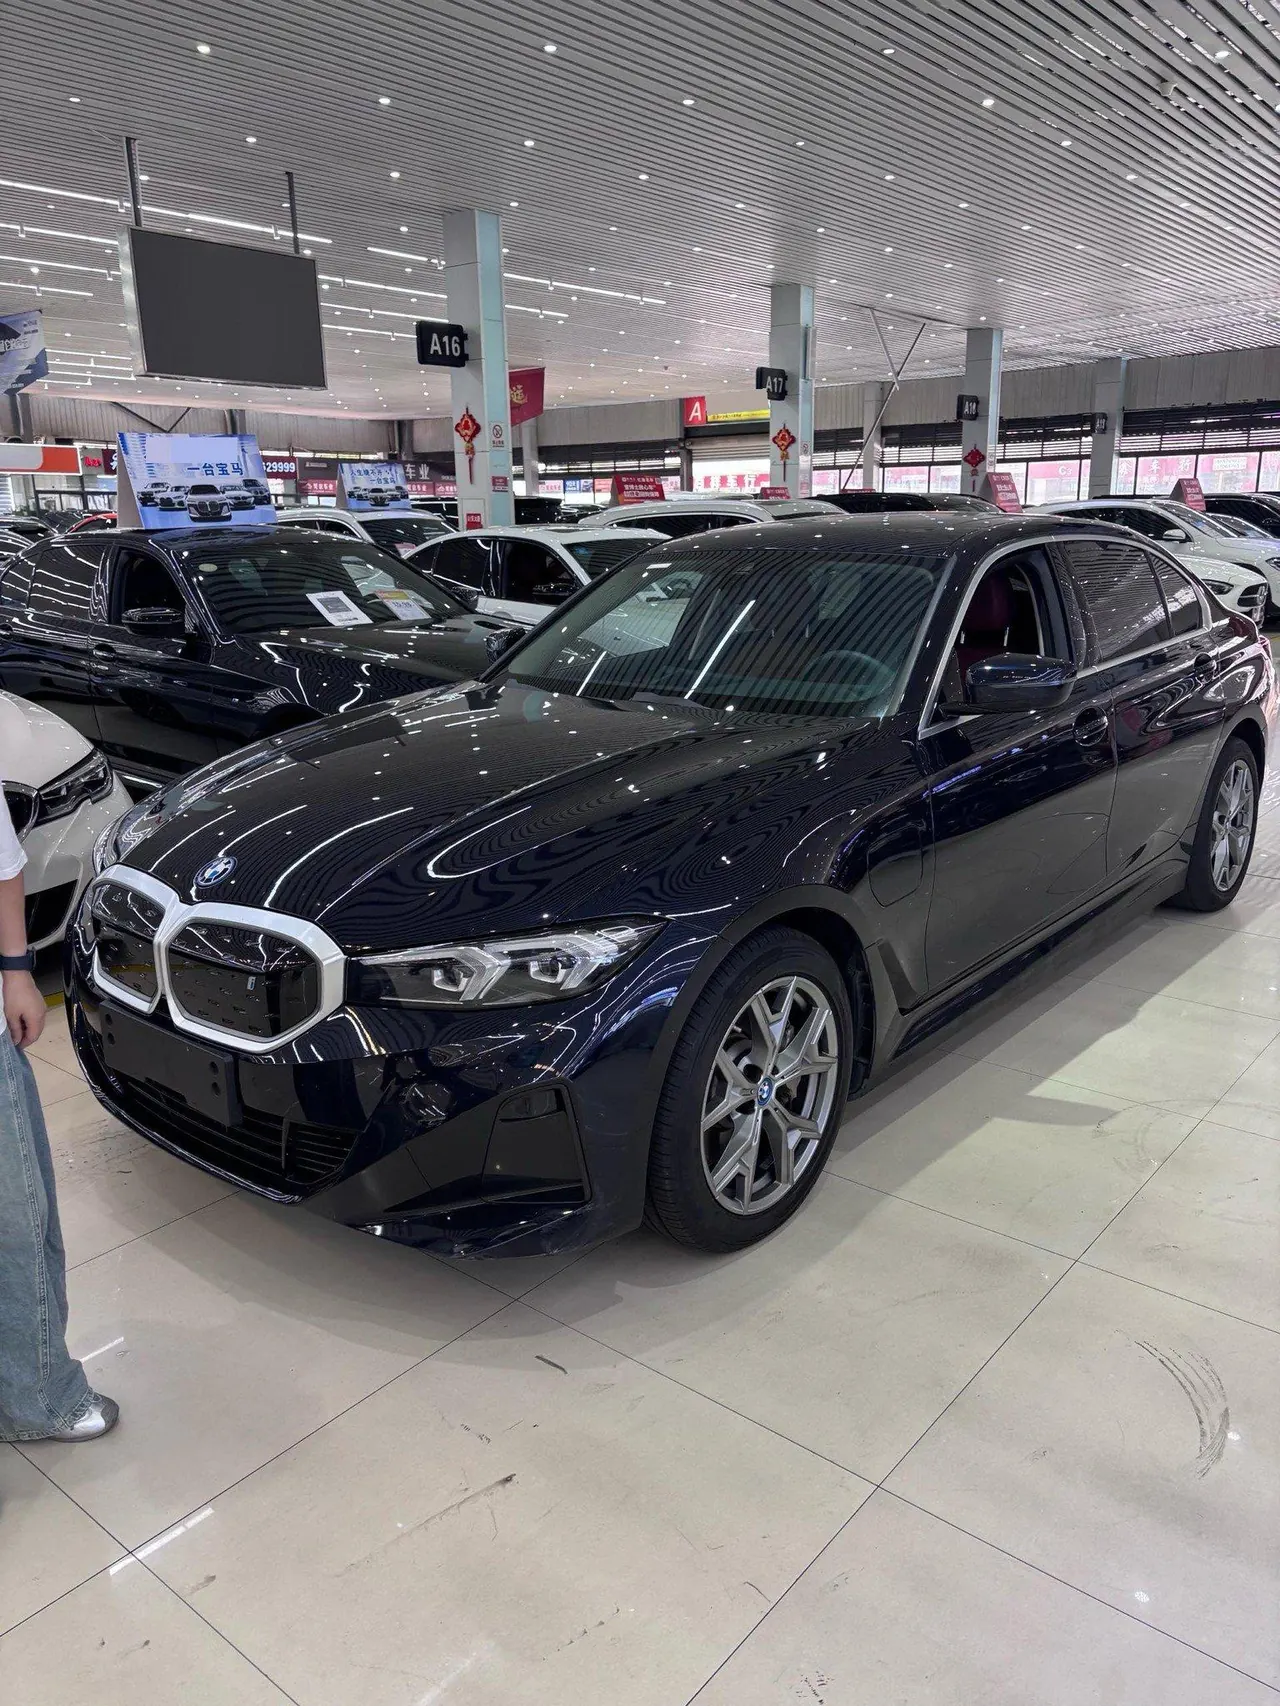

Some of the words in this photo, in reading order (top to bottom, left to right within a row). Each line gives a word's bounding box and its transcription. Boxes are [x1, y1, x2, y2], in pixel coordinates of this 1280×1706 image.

[430, 333, 461, 357] A16
[766, 375, 784, 393] A17
[688, 401, 702, 421] A
[187, 462, 244, 477] 一台宝马
[404, 463, 430, 479] 车业
